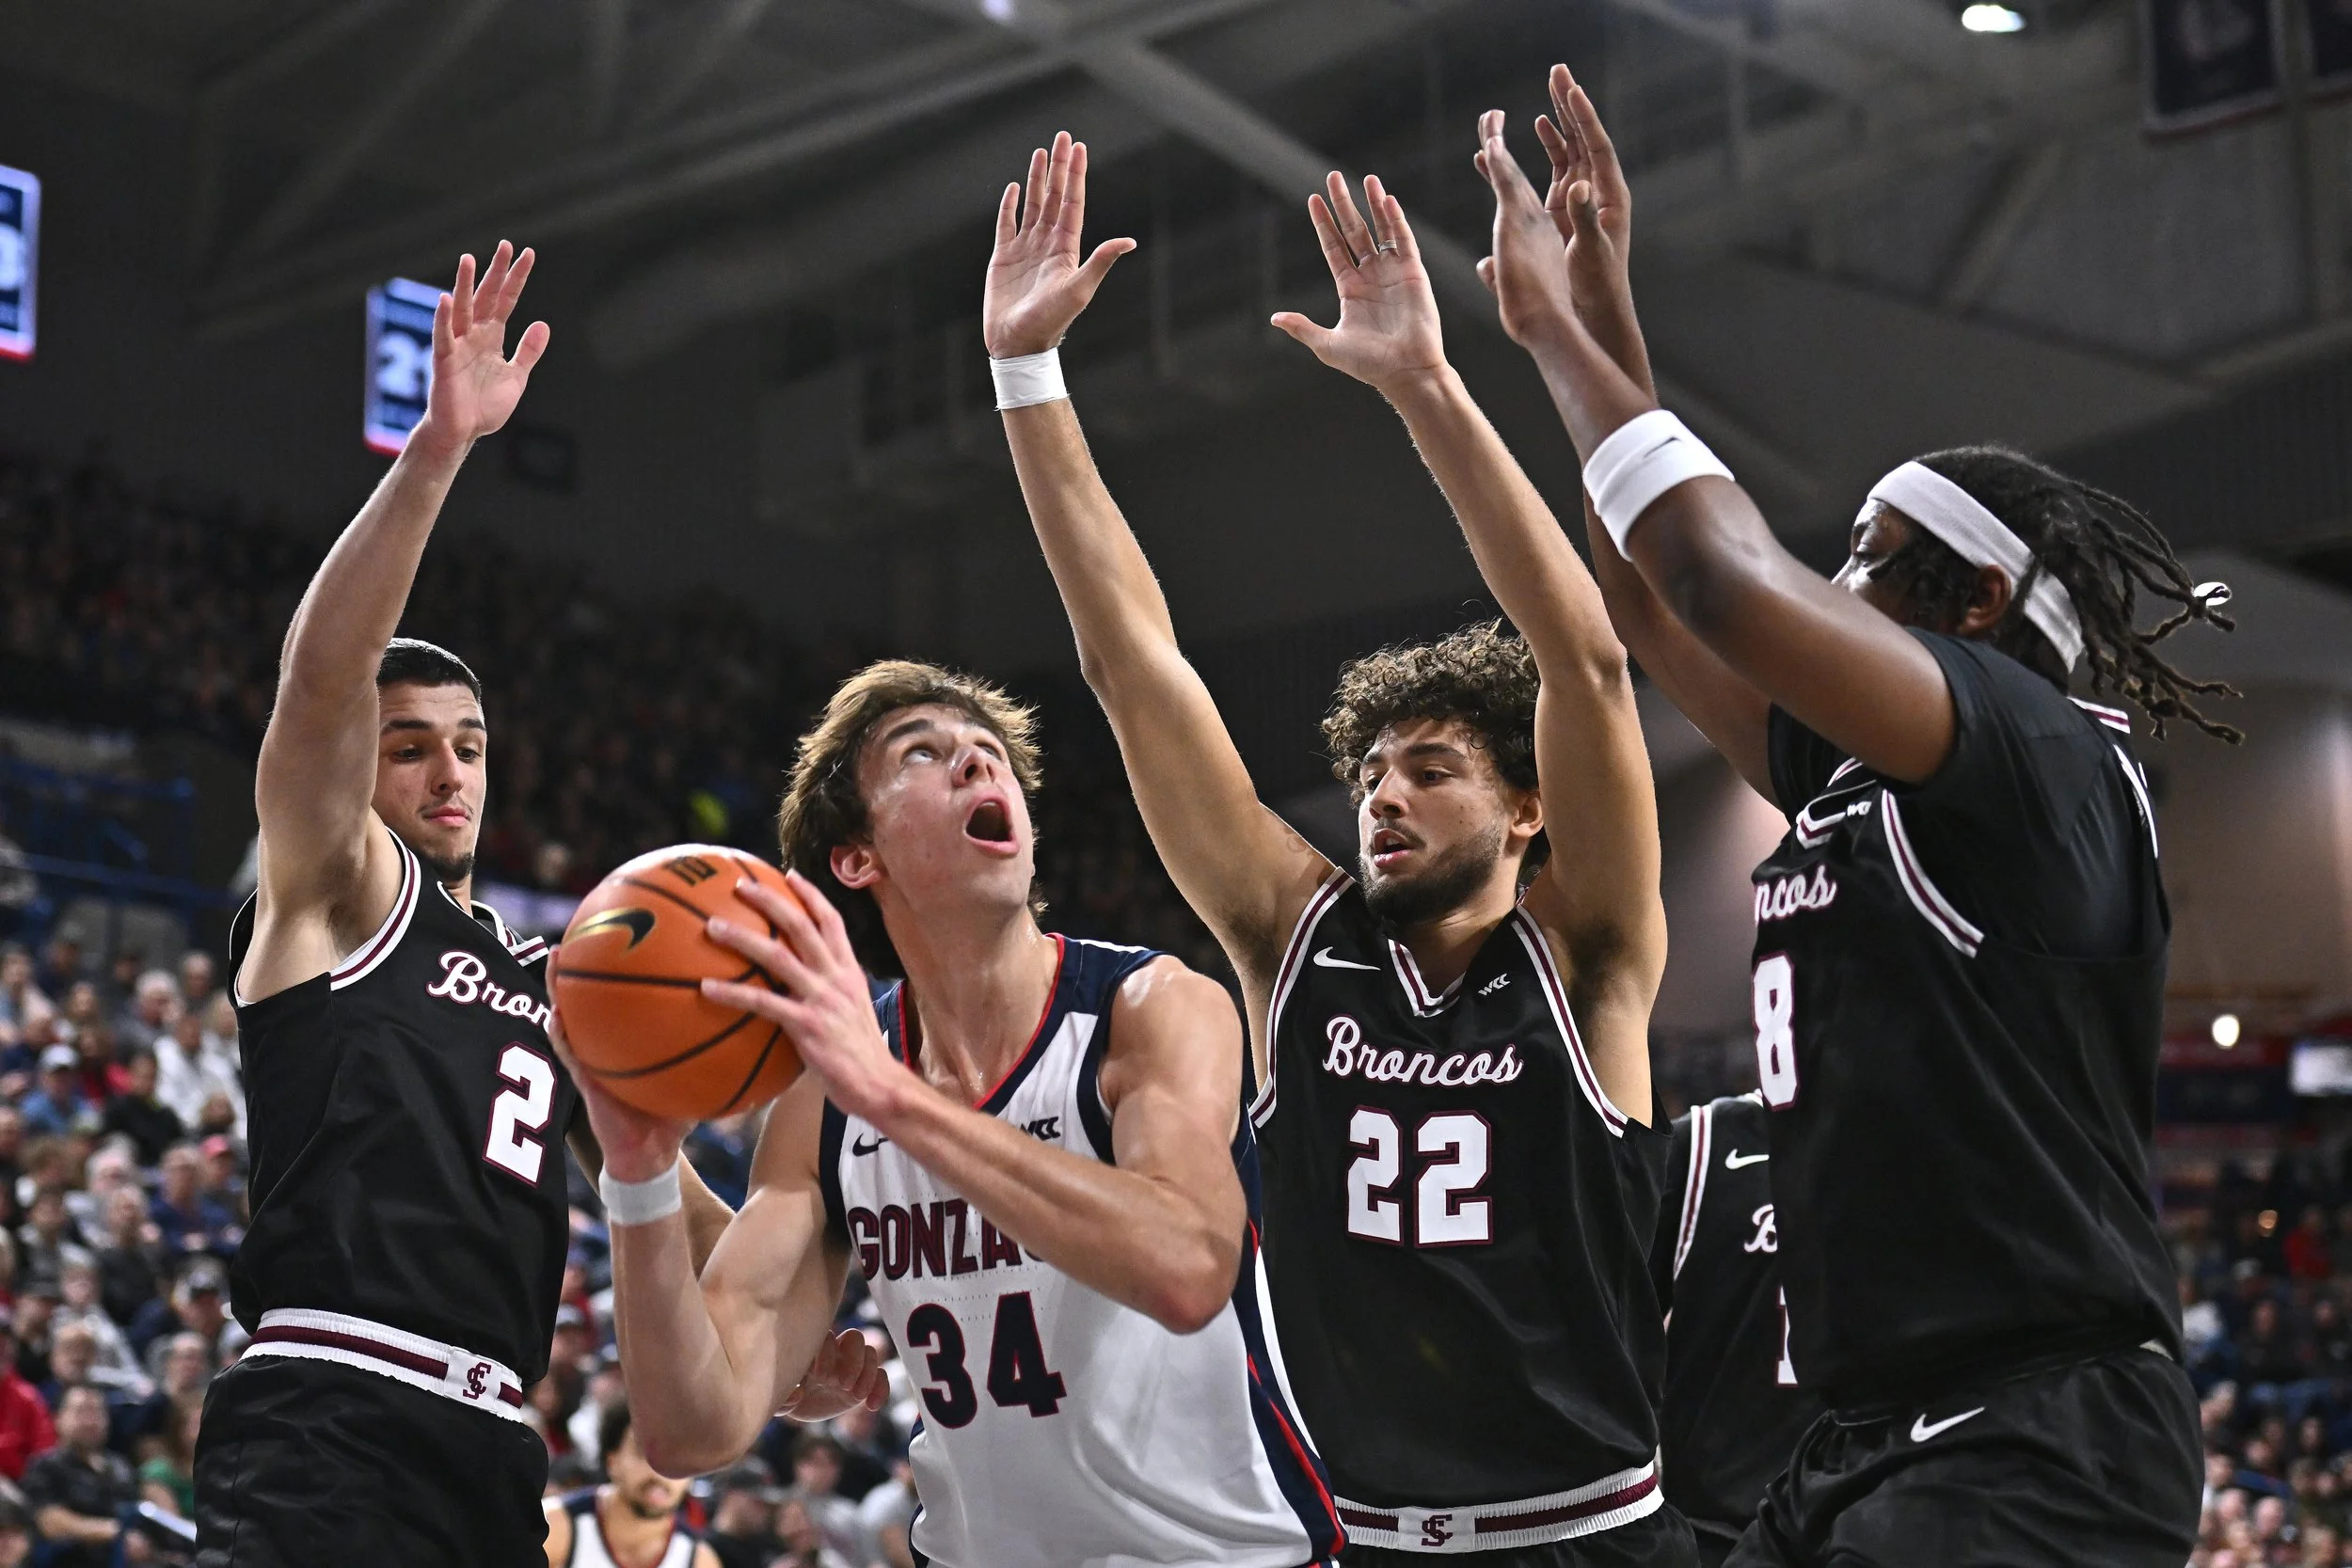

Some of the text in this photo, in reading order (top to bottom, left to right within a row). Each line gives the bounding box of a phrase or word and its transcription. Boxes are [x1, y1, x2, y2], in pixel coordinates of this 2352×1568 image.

[1321, 1013, 1525, 1086] Broncos
[1752, 952, 1801, 1113] 8
[482, 1041, 558, 1189] 2
[1346, 1104, 1493, 1249] 22
[848, 1197, 1045, 1281] GONZA
[907, 1291, 1067, 1430] 34
